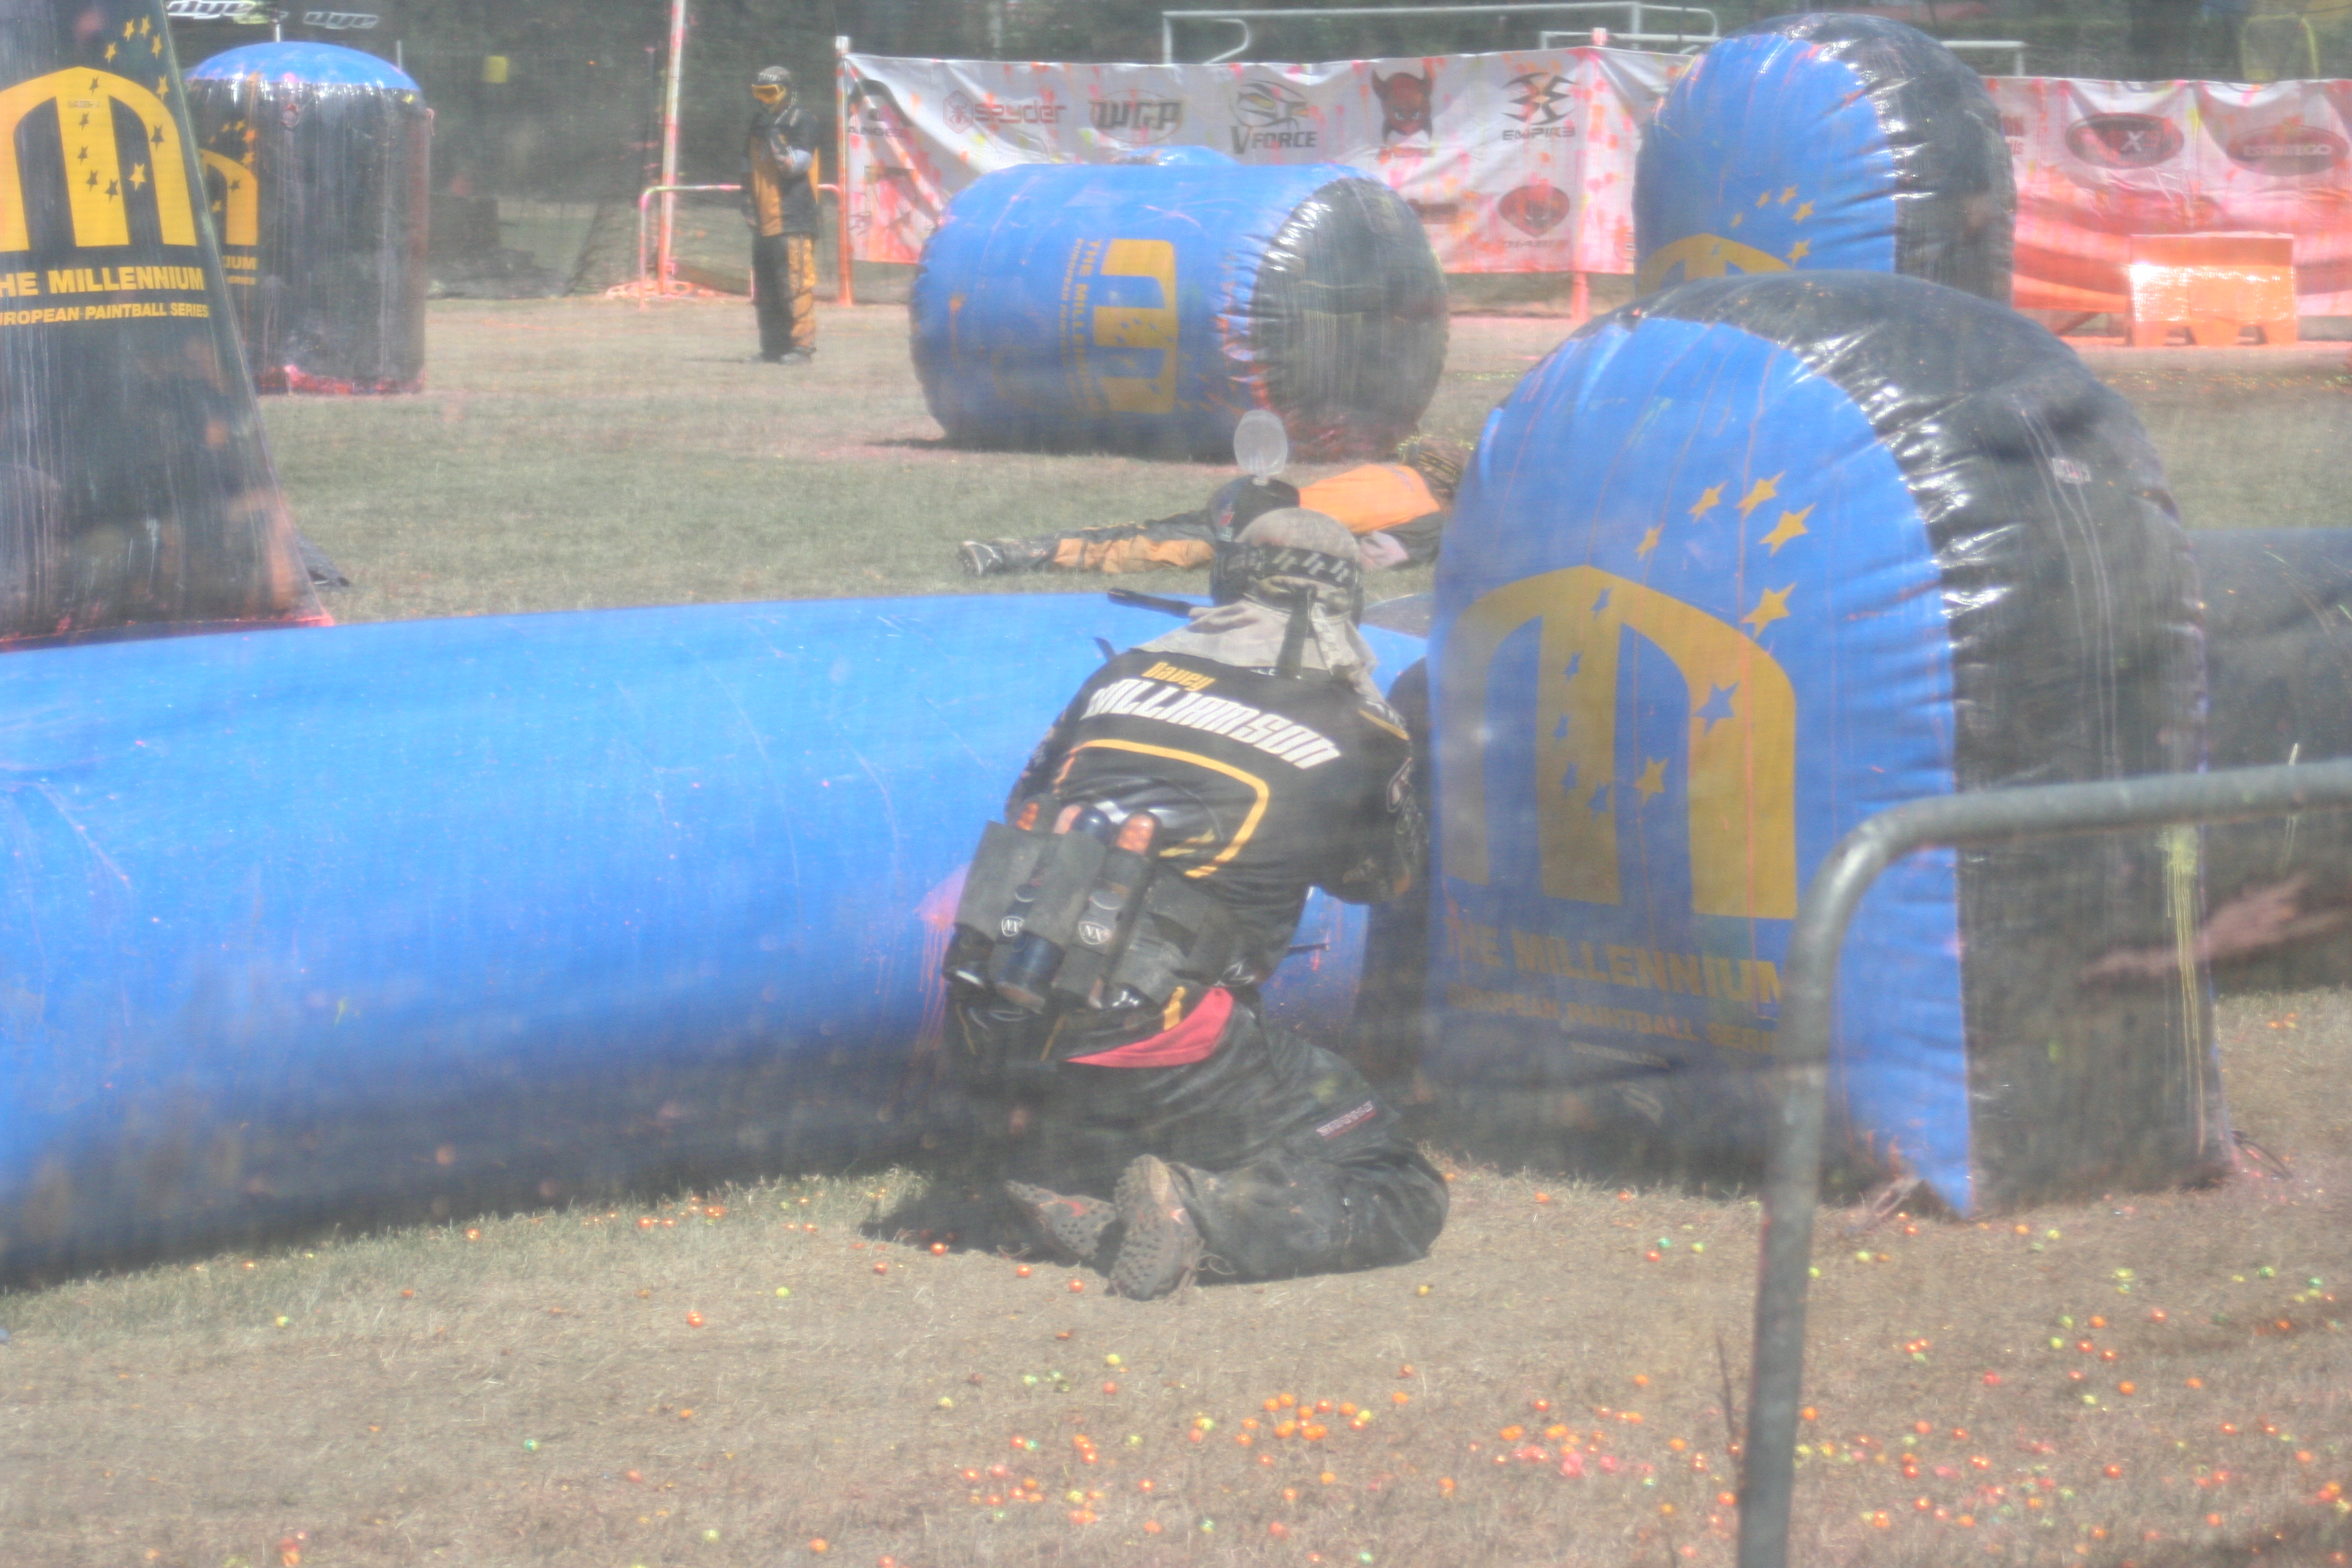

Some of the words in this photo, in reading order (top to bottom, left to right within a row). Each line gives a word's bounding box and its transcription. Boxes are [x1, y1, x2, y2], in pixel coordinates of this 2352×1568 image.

[0, 272, 38, 297] HE
[48, 265, 205, 293] MILLENNIUM
[0, 307, 80, 326] ROPEAN
[84, 302, 167, 320] PAINTBALL
[170, 302, 209, 318] SERIES
[1079, 679, 1341, 770] WILLIAMSON
